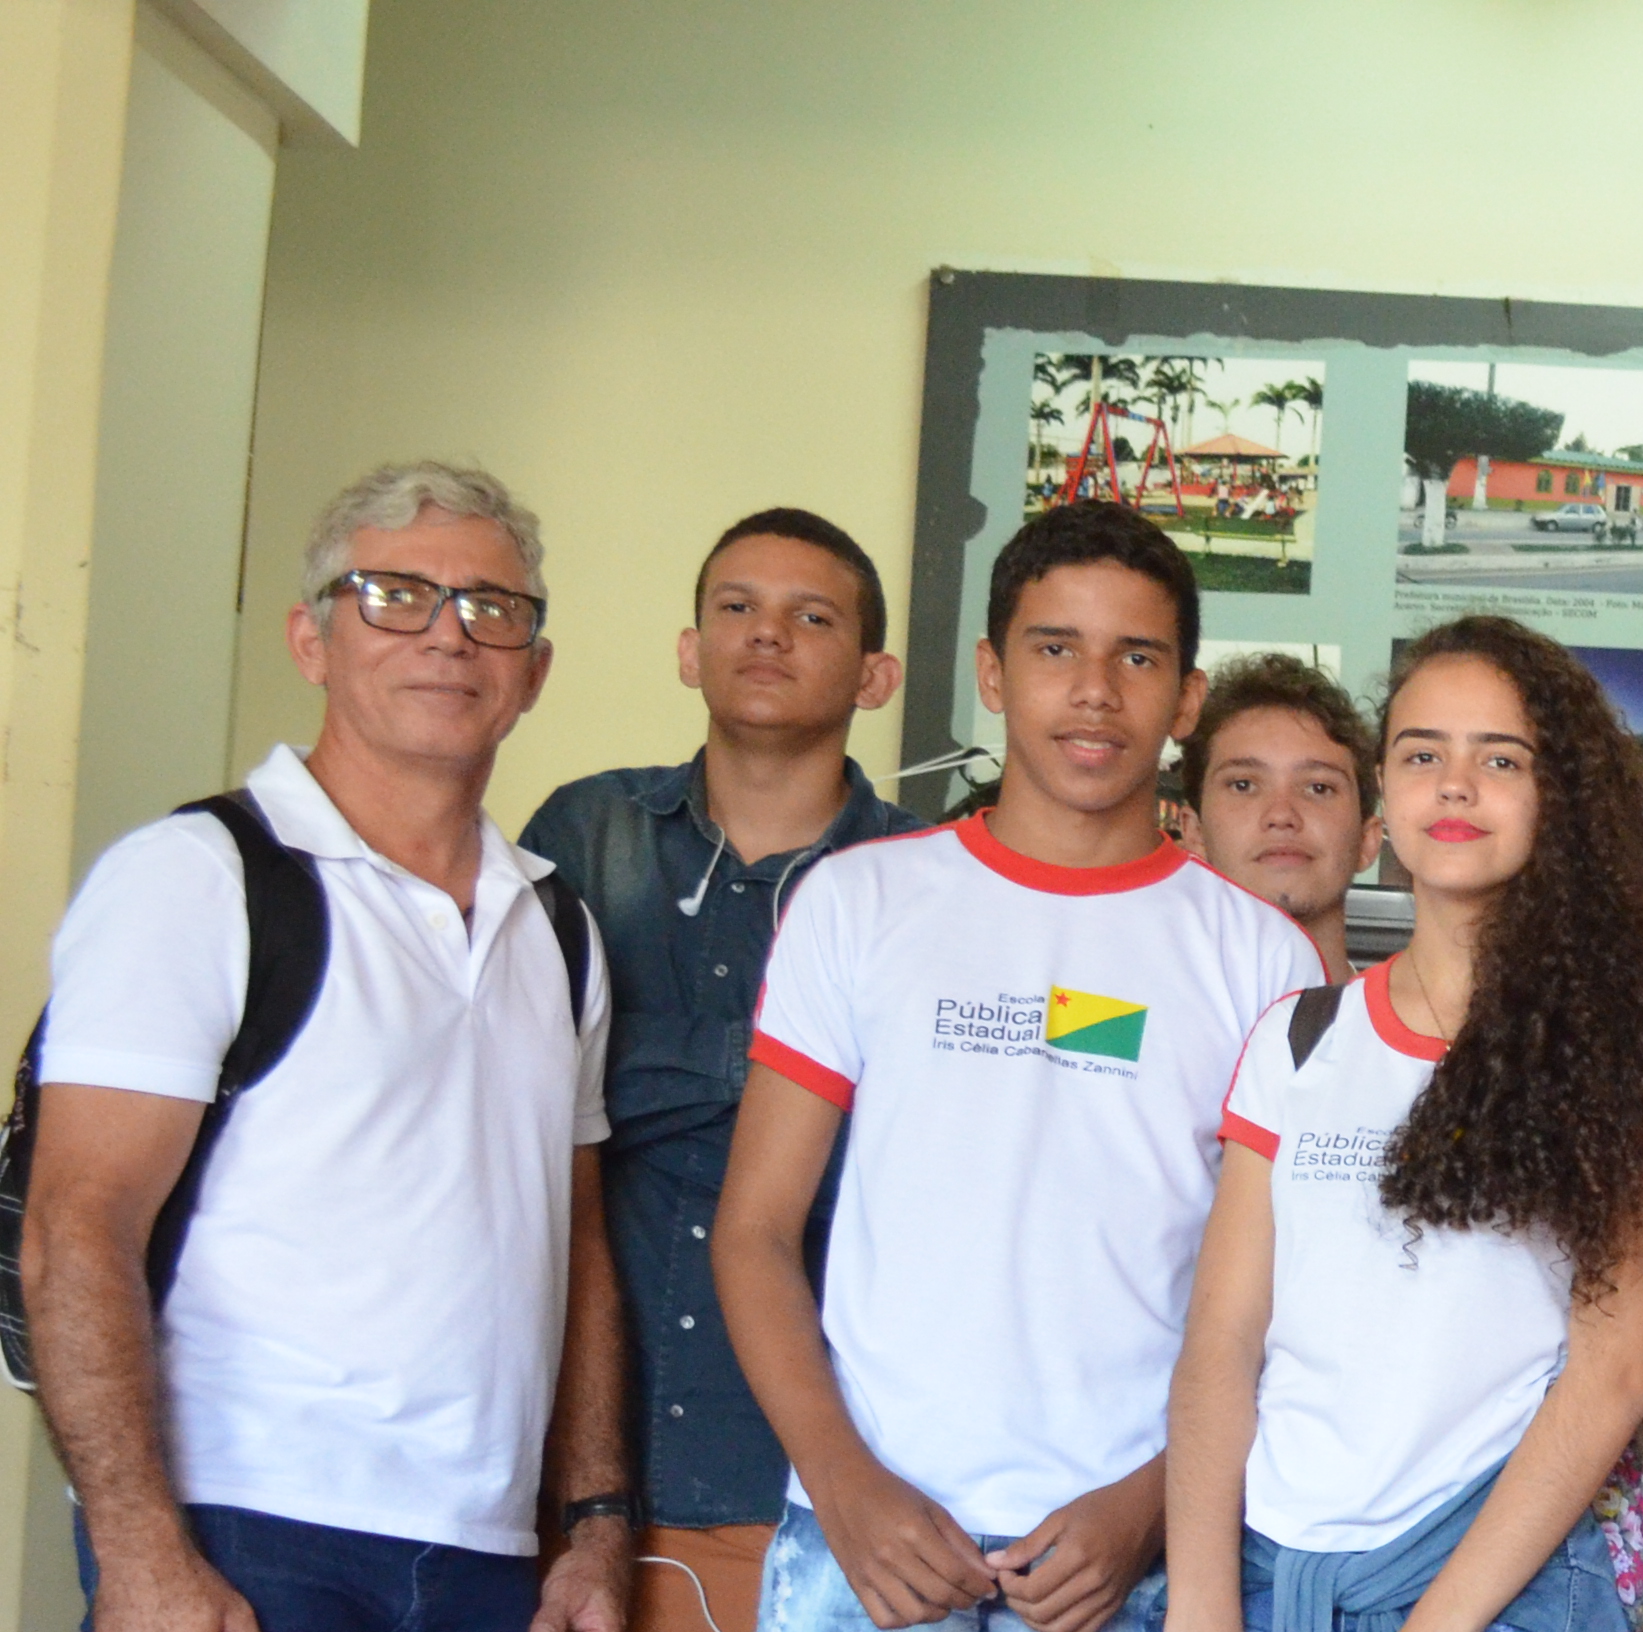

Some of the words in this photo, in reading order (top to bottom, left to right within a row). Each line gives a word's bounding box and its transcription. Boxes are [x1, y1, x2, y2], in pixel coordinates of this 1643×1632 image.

[1573, 598, 1595, 608] 2004
[1562, 607, 1598, 619] SECOM
[998, 993, 1045, 1005] Escola
[936, 998, 1043, 1025] Pública
[935, 1018, 1041, 1042] Estadual
[960, 1041, 999, 1055] Célia
[1004, 1045, 1078, 1070] Cabanellas
[1082, 1061, 1139, 1081] Zannini
[1297, 1132, 1382, 1151] Públic
[1293, 1150, 1387, 1167] Estadua
